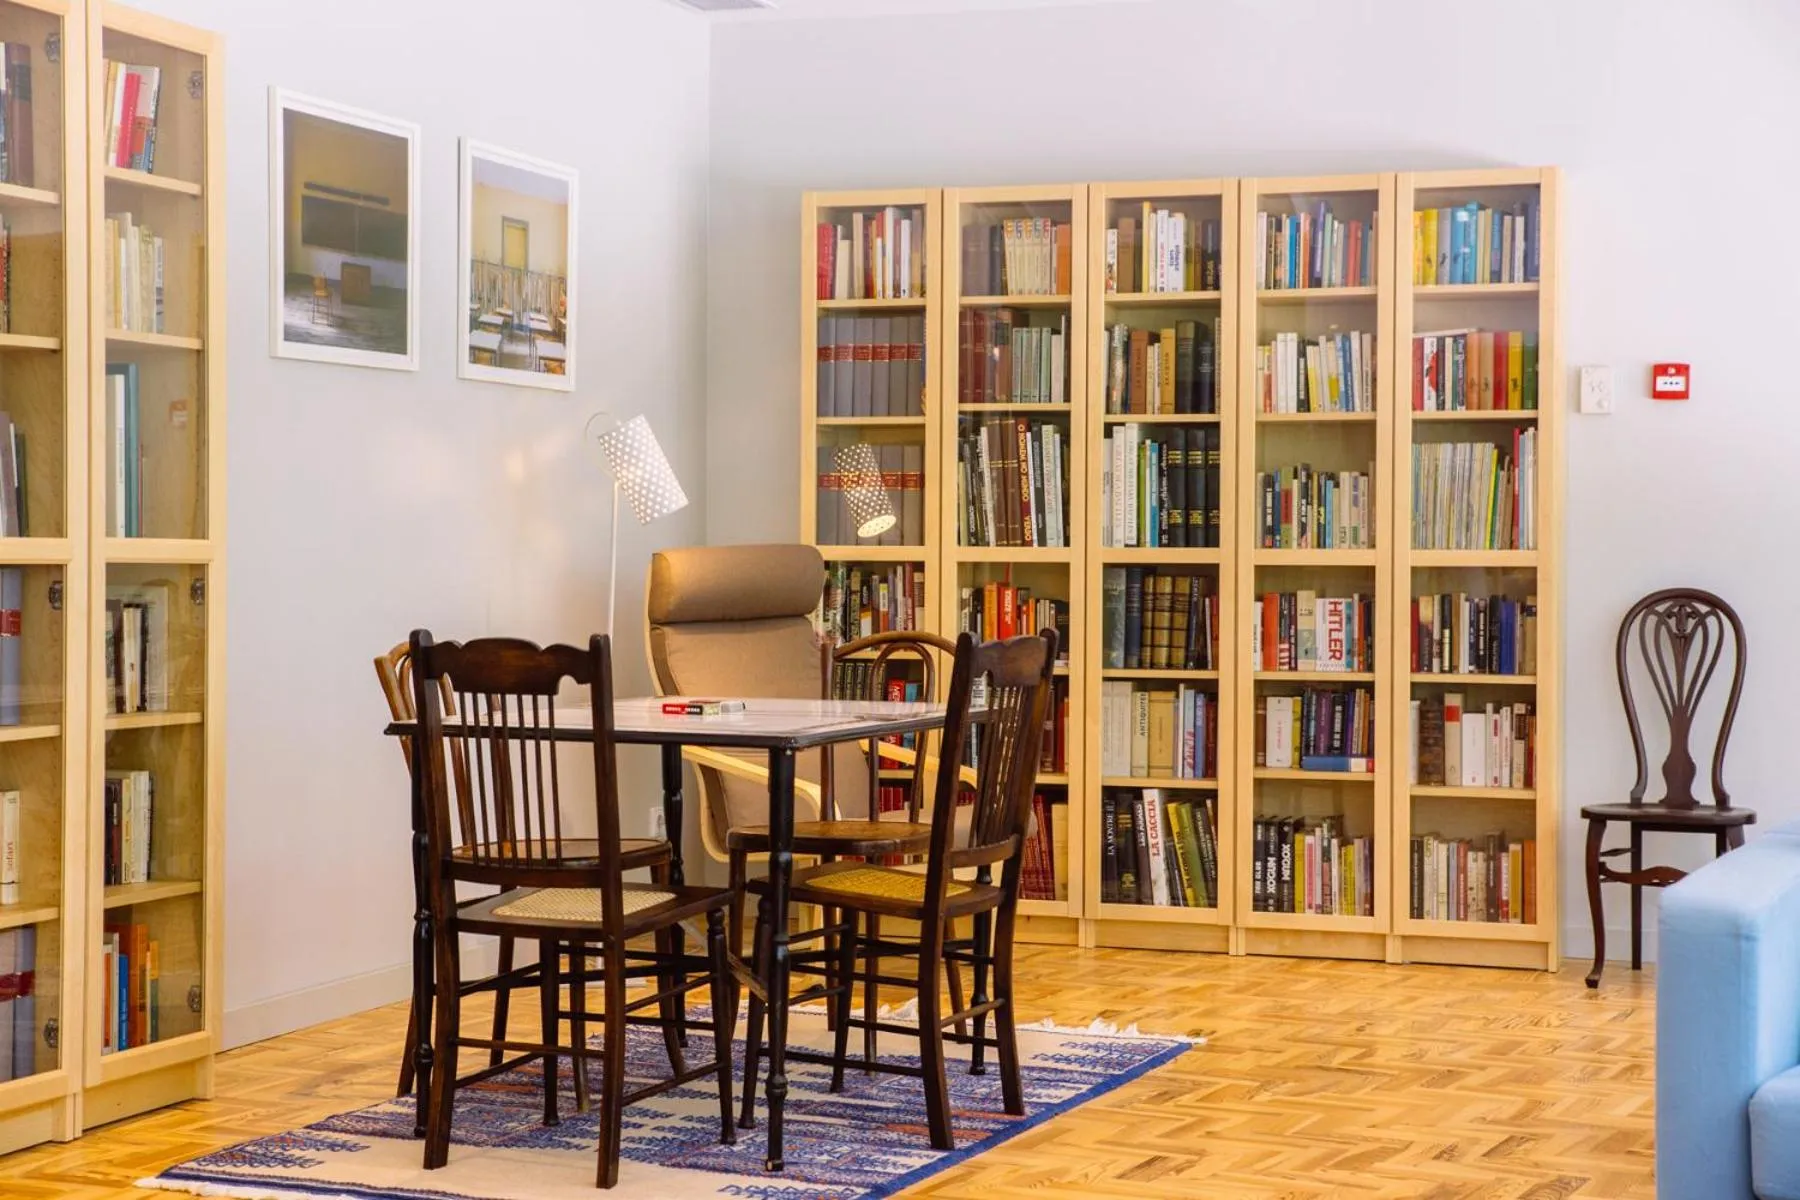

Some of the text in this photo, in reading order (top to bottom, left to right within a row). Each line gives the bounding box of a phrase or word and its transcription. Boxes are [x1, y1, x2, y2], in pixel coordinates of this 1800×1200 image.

[1017, 424, 1029, 501] O HOMEM NO MUNDO
[1023, 514, 1032, 541] VERBO
[1328, 600, 1343, 661] HITLER
[1107, 845, 1114, 855] LA
[1148, 799, 1160, 857] LA CACCIA
